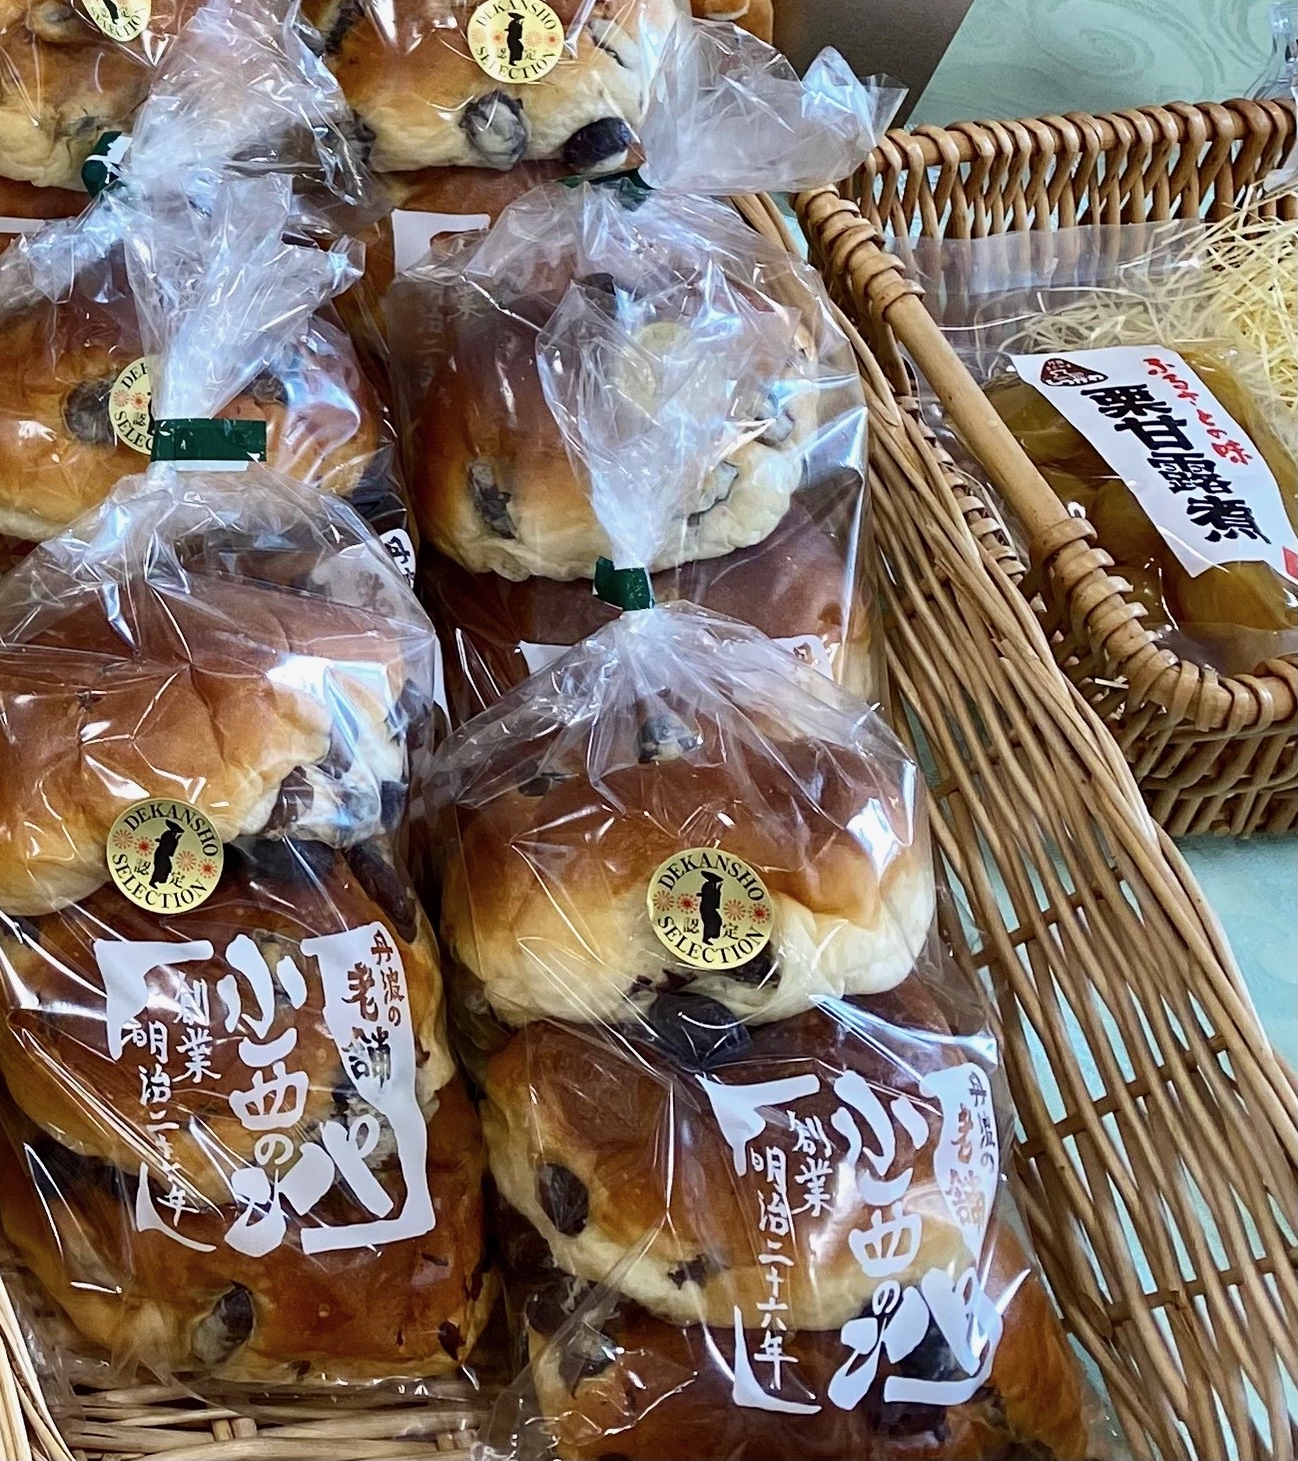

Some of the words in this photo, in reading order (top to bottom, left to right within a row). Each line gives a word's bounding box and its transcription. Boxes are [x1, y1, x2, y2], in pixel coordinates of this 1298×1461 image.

[1080, 382, 1272, 545] 栗甘露煮
[123, 802, 219, 857] DEKANSHO
[112, 853, 208, 909] SELECTION
[657, 852, 765, 902] DEKANSHO
[657, 915, 765, 964] SELECTION
[748, 1145, 797, 1391] 明治二十六年
